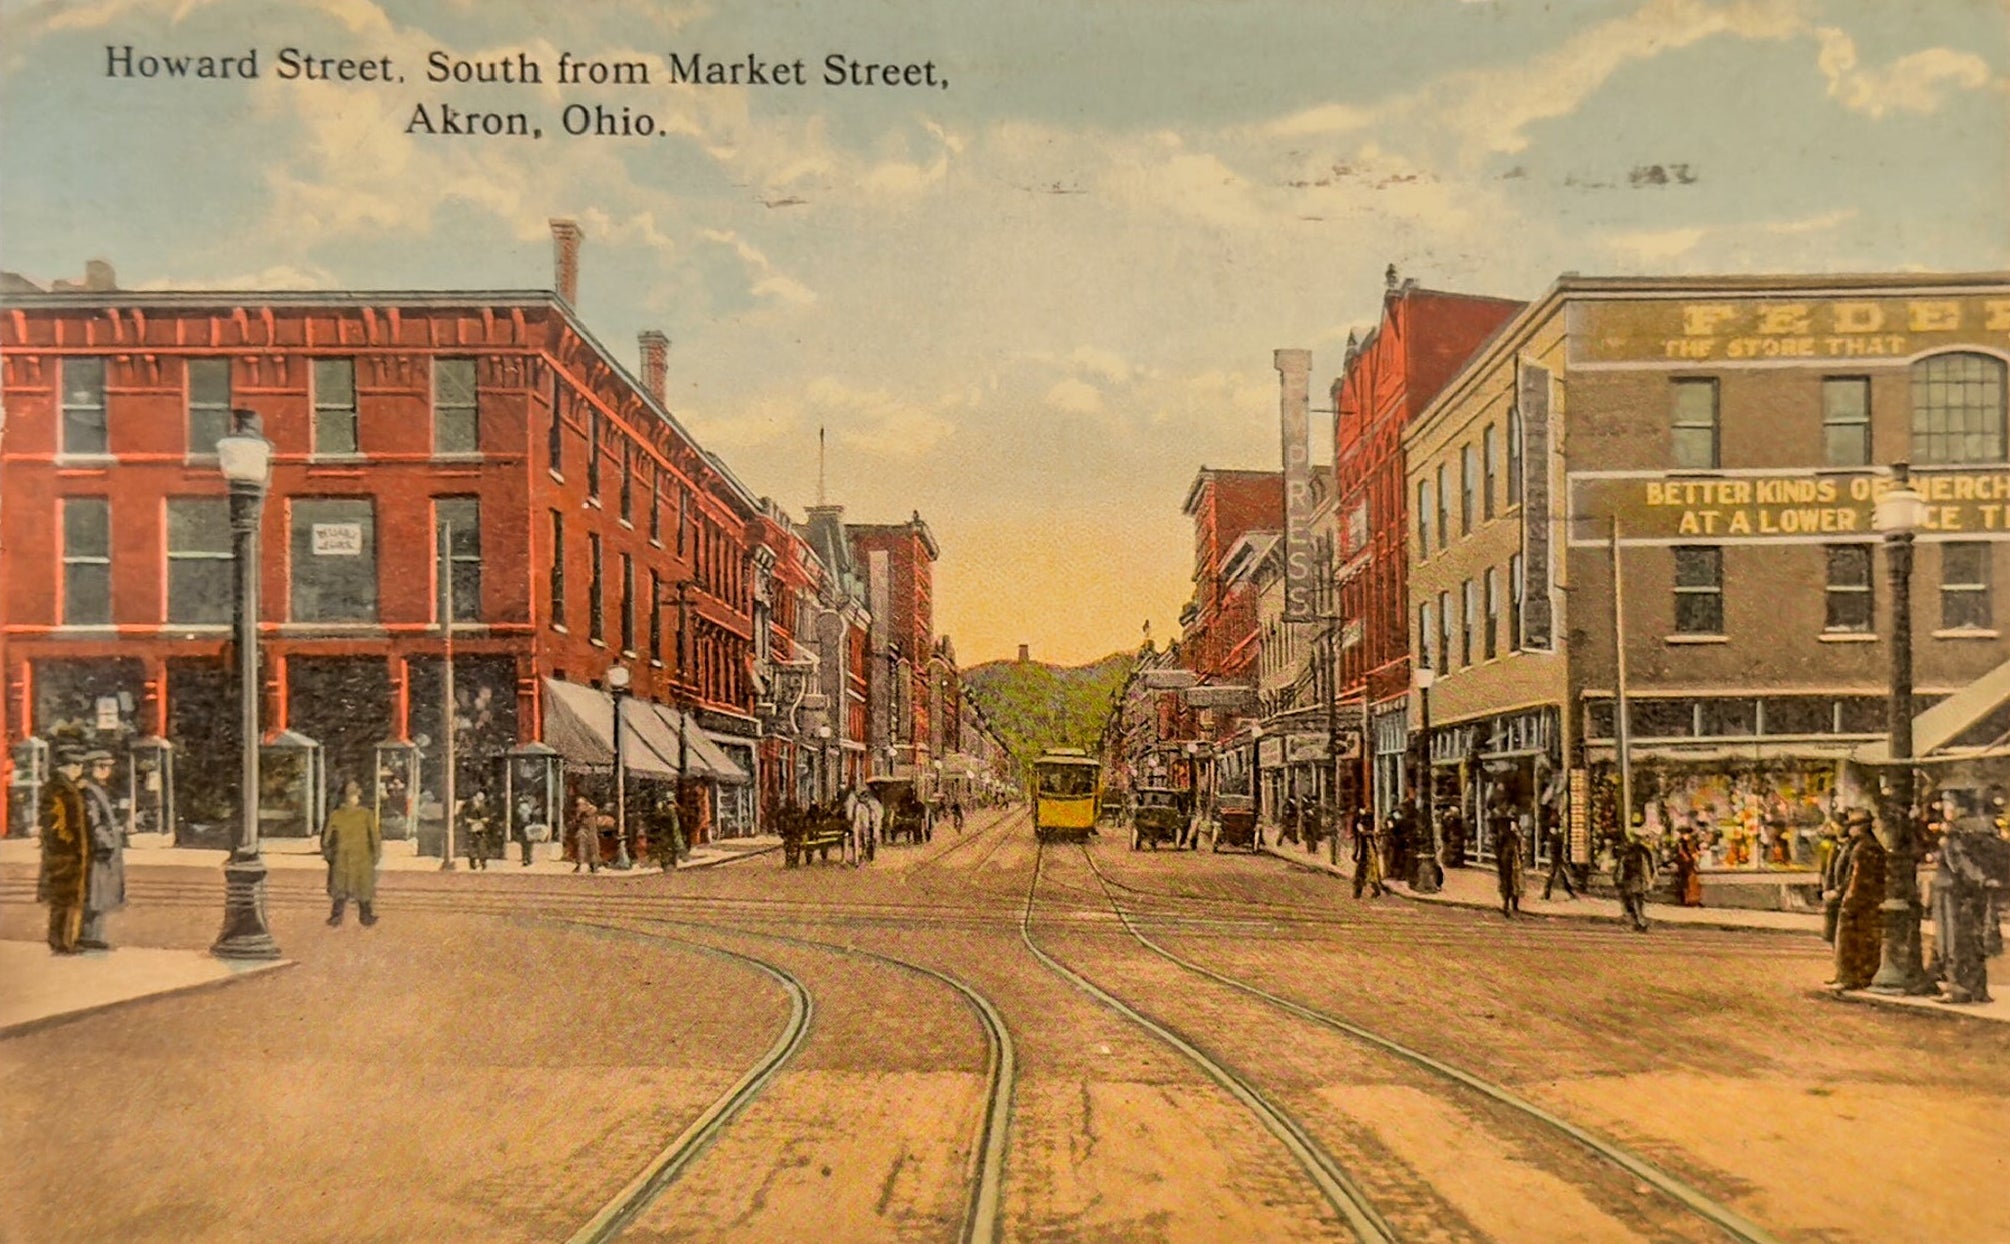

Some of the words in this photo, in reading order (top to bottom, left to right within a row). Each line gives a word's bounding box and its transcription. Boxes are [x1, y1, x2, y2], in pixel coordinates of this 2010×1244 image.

[1727, 337, 1815, 357] STORE
[1824, 336, 1905, 354] THAT
[1646, 480, 1750, 505] BETTER
[1756, 479, 1837, 502] KINDS
[1679, 510, 1719, 534] AT
[1729, 511, 1750, 533] A
[1759, 508, 1857, 533] LOWER
